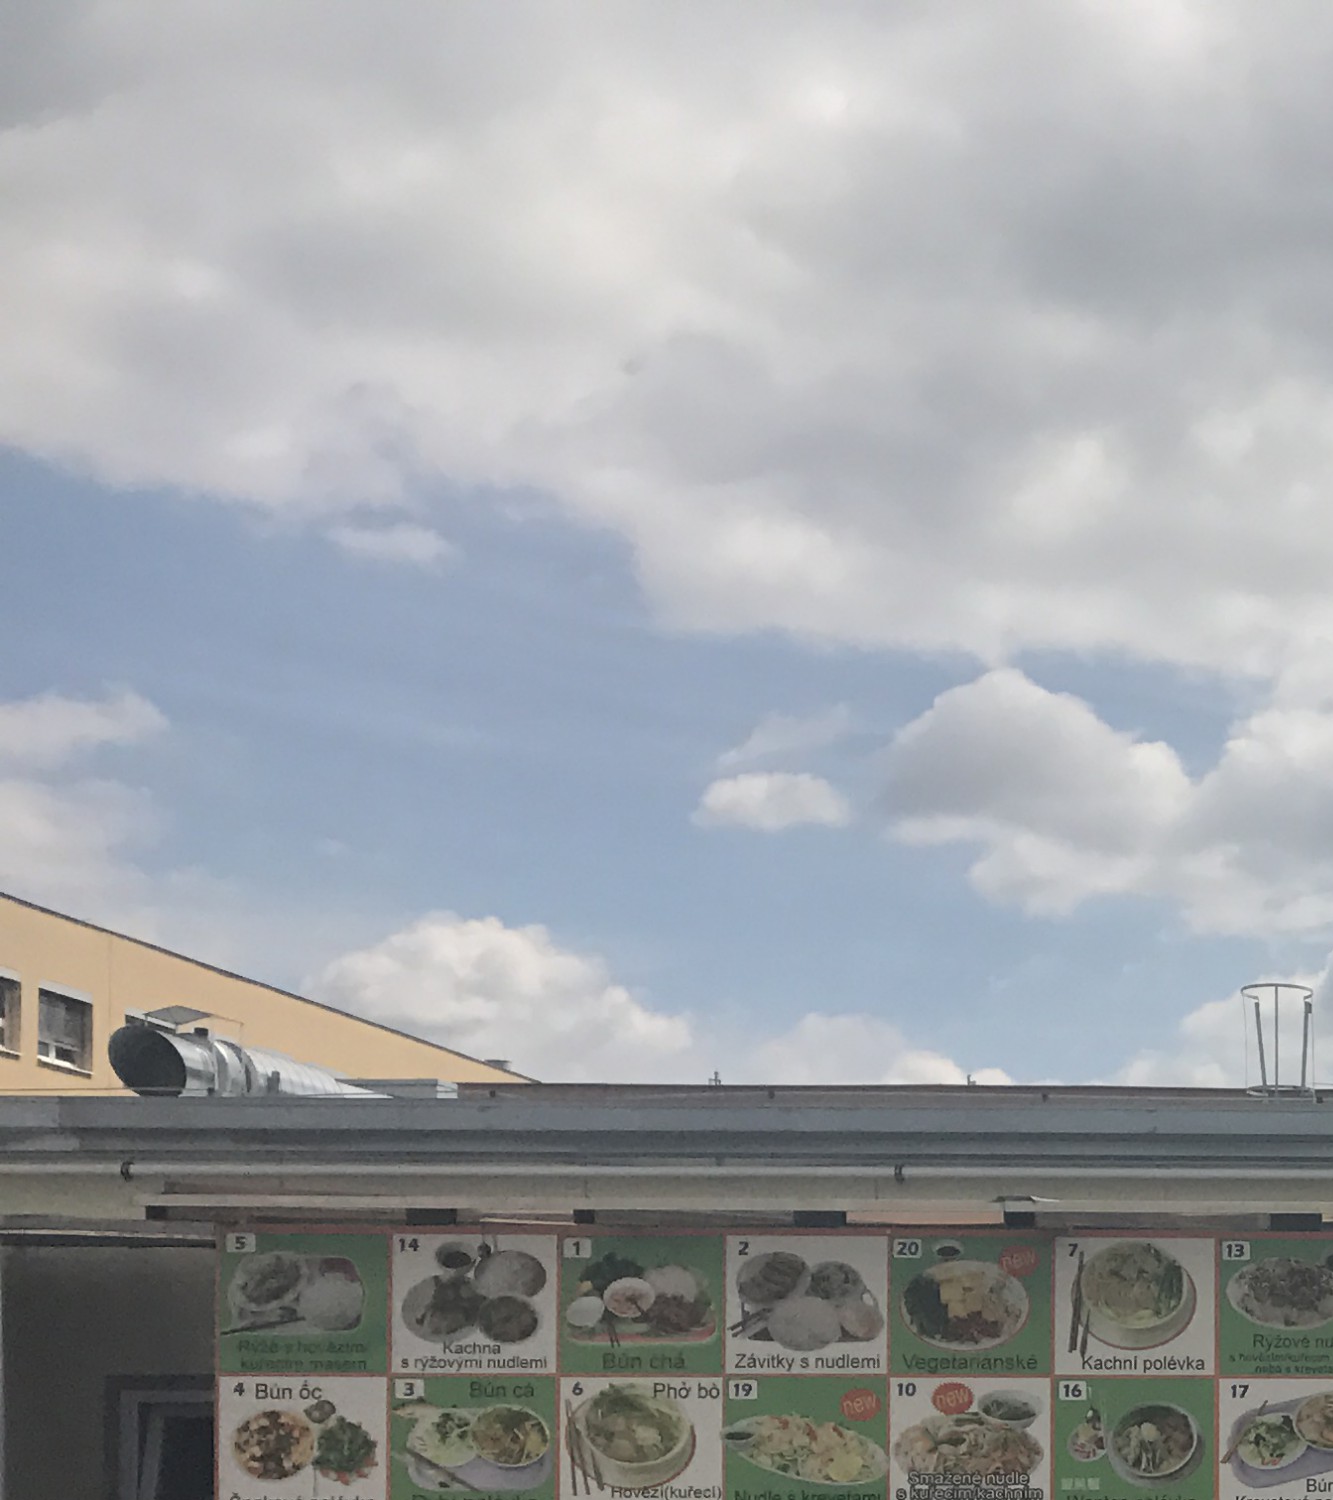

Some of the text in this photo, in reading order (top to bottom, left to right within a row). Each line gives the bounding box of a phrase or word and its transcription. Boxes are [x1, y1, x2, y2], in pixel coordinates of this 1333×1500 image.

[234, 1236, 246, 1250] 5
[399, 1238, 419, 1252] 14
[572, 1242, 581, 1255] 1
[738, 1242, 749, 1255] 2
[896, 1242, 919, 1256] 20
[1069, 1243, 1078, 1257] 7
[1226, 1244, 1244, 1257] 13
[1000, 1248, 1036, 1271] new
[442, 1341, 501, 1356] Kachna
[401, 1358, 409, 1369] s
[487, 1356, 548, 1369] nudlemi
[735, 1353, 881, 1371] Závitky s nudlemi
[1081, 1355, 1206, 1373] Kachní polévka
[233, 1382, 245, 1397] 4
[255, 1383, 293, 1400] Bún
[403, 1382, 415, 1396] 3
[470, 1381, 506, 1398] Bún
[572, 1382, 583, 1395] 6
[733, 1384, 753, 1398] 19
[896, 1384, 916, 1397] 10
[1064, 1384, 1082, 1398] 16
[1231, 1385, 1249, 1398] 17
[843, 1393, 876, 1415] new
[936, 1388, 969, 1408] new
[908, 1470, 1030, 1486] Smažené nudle
[896, 1488, 907, 1500] s
